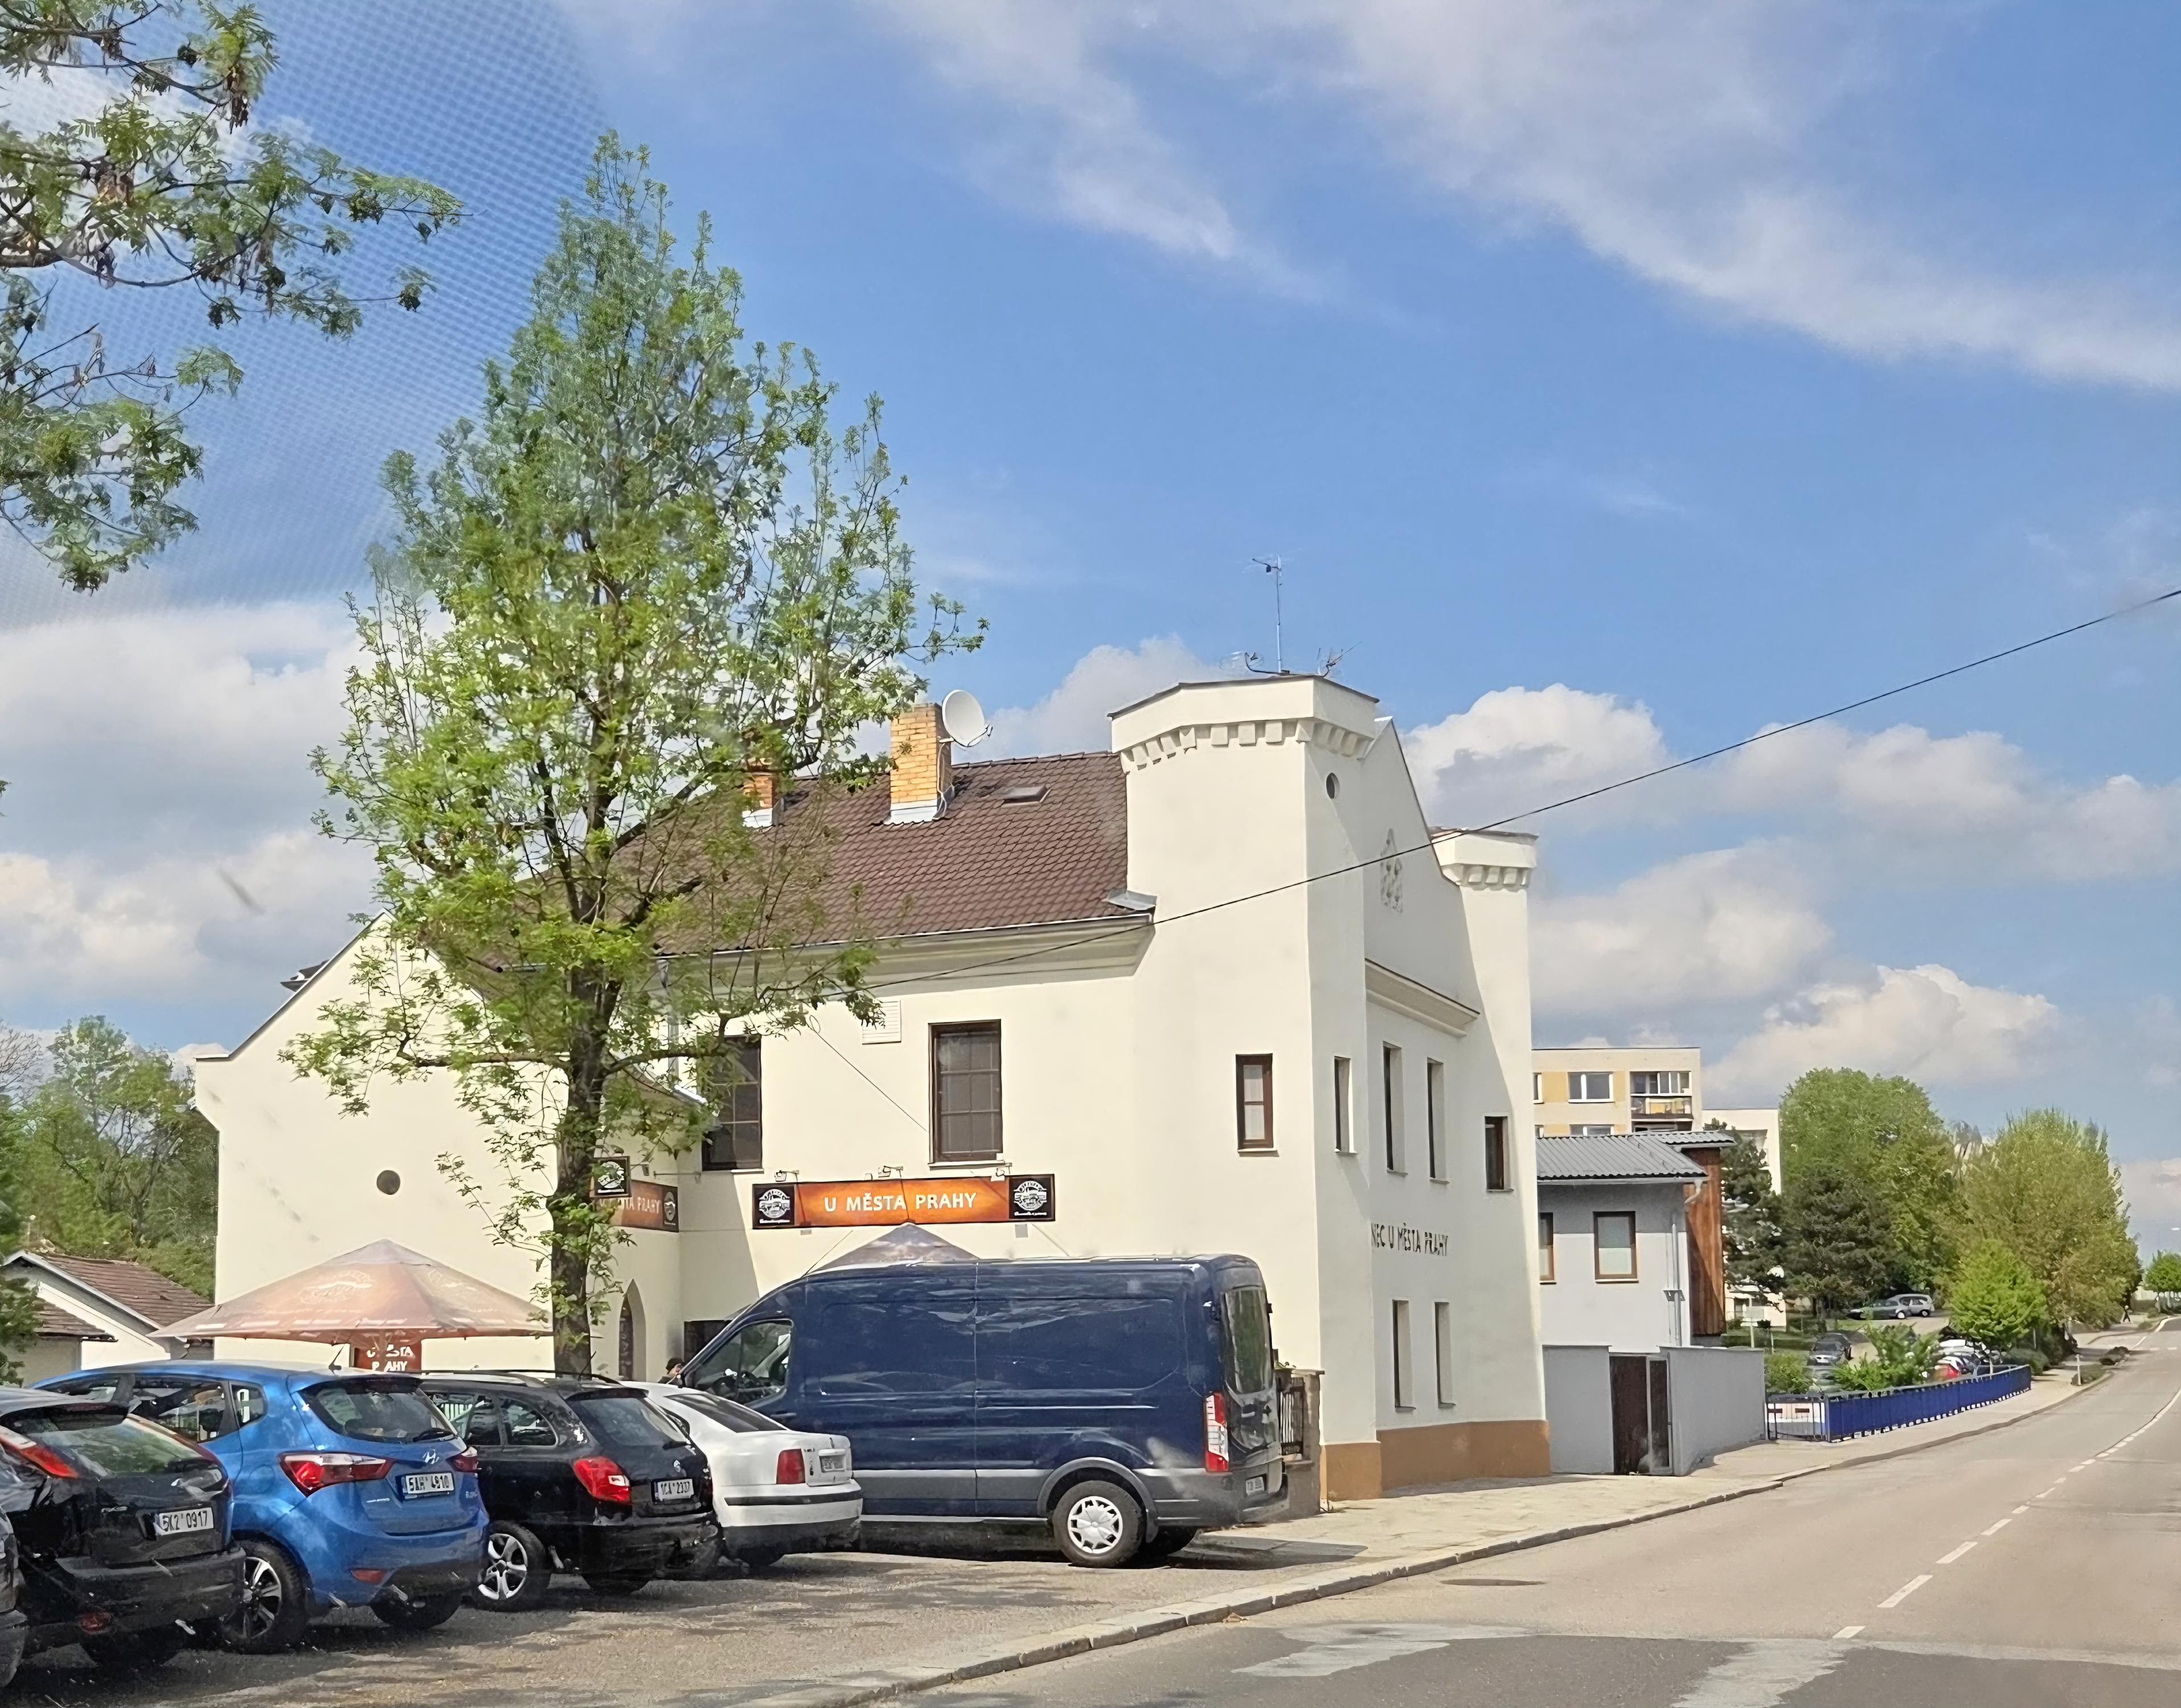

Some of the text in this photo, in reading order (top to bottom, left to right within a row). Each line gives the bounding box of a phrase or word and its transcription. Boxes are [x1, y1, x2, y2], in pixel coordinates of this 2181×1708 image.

[824, 1192, 977, 1212] U MĚSTA PRAHY
[1388, 1225, 1394, 1249] U
[371, 1361, 408, 1373] PAHY
[186, 1510, 208, 1529] 0917
